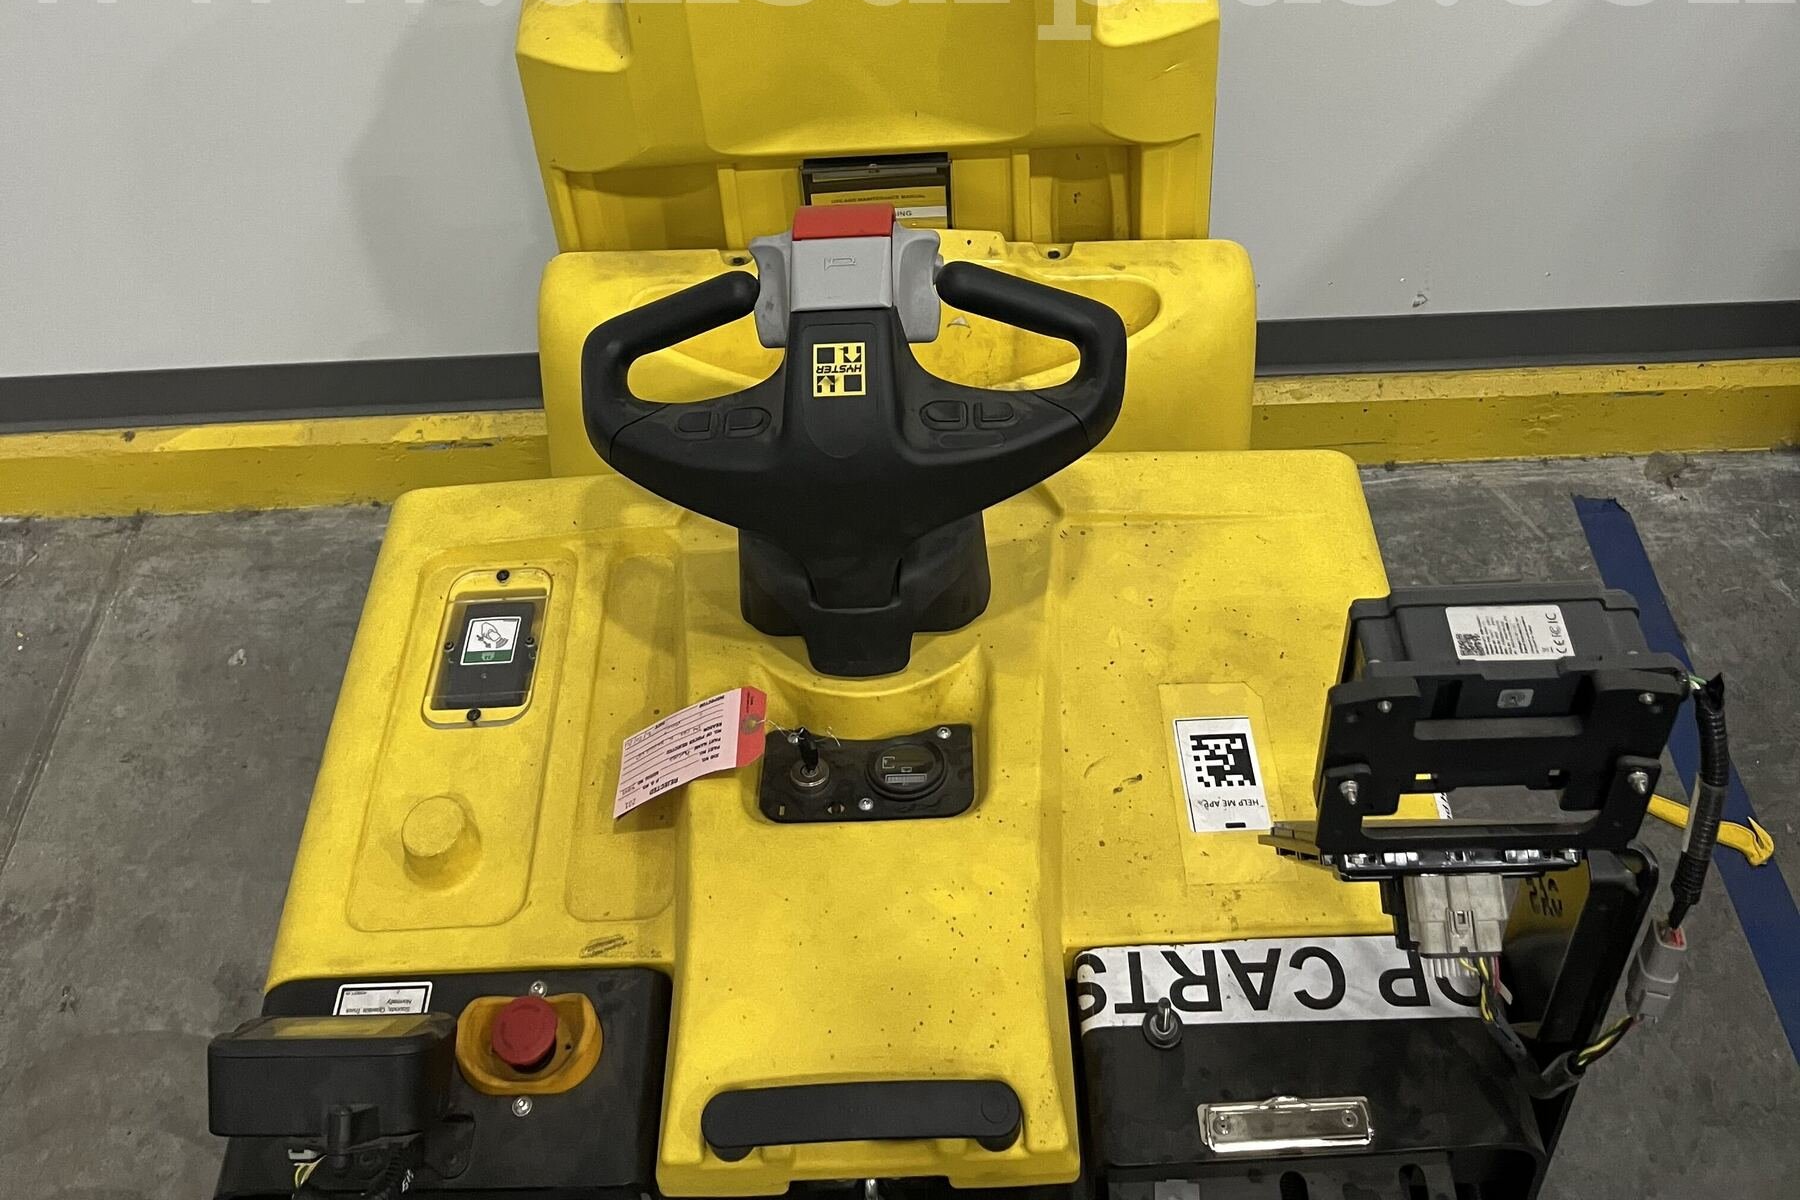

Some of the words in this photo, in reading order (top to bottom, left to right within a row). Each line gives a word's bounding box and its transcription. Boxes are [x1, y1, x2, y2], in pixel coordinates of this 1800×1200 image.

[816, 364, 862, 374] HYSTER
[703, 722, 722, 732] REASON
[694, 741, 708, 751] NAME
[708, 737, 721, 745] PART
[707, 745, 721, 753] PART
[649, 777, 679, 795] REJECTED
[1222, 799, 1236, 807] ME
[1238, 798, 1259, 807] HELP
[1076, 946, 1346, 1022] CARTS
